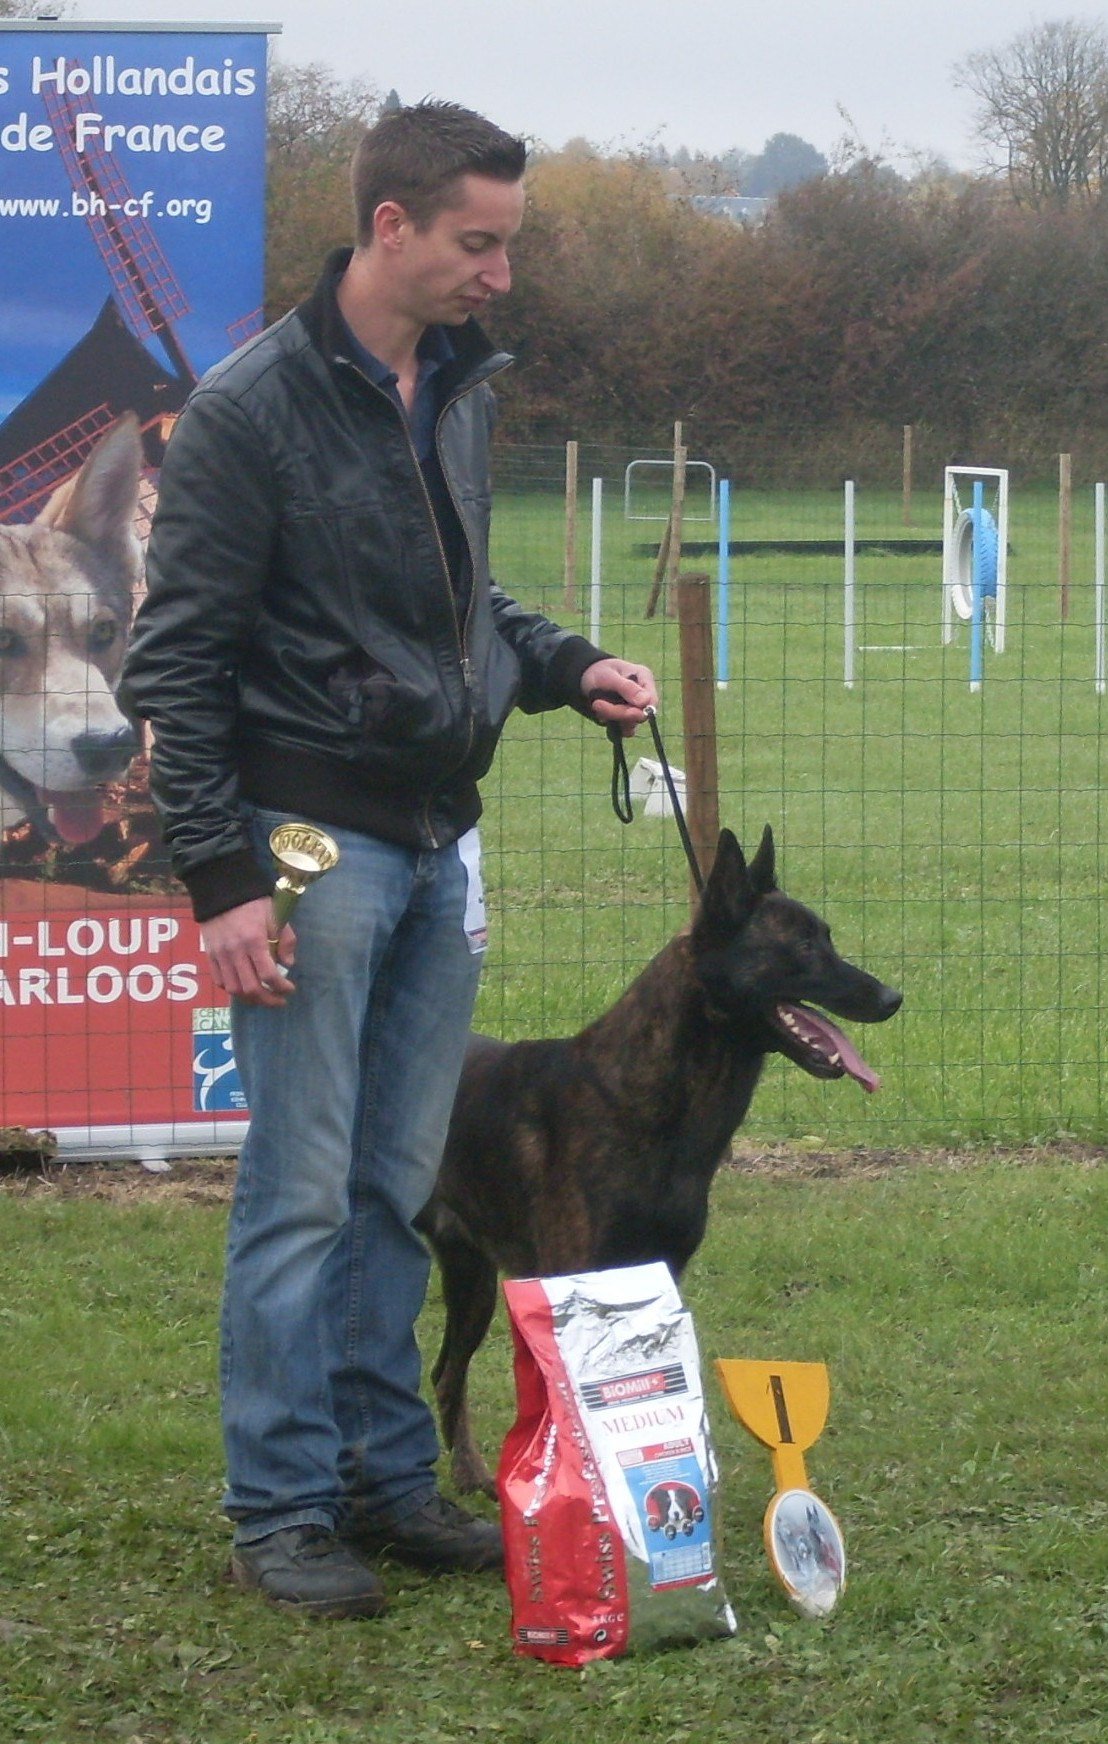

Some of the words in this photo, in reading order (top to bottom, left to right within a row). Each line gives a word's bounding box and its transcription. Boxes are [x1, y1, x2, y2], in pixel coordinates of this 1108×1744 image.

[0, 67, 10, 96] s
[32, 56, 256, 96] Hollandais
[1, 112, 54, 152] de
[75, 112, 226, 152] France
[0, 191, 212, 224] www.bh-cf.org
[602, 1404, 685, 1434] MEDIUM
[766, 1375, 796, 1443] 1
